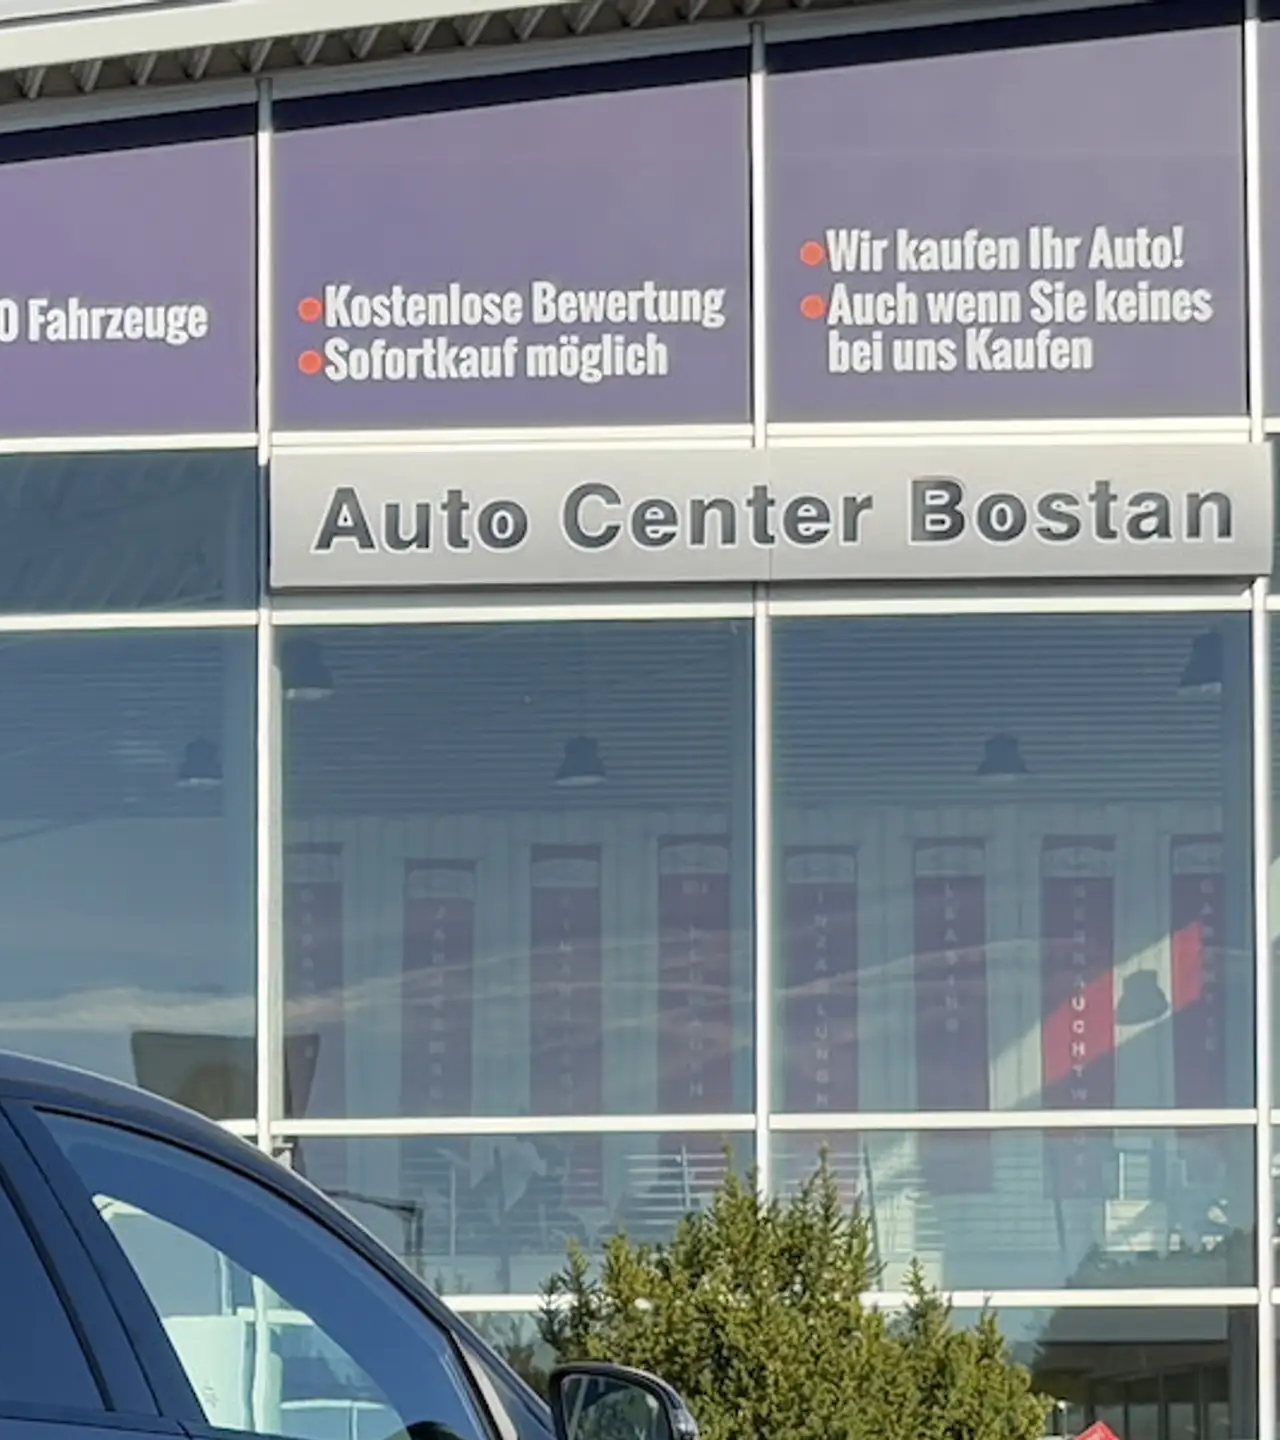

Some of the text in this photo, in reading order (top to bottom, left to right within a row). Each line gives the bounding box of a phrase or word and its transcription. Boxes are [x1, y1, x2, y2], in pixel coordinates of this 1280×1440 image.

[826, 225, 1184, 271] Wir kaufen Ihr Auto!
[28, 297, 208, 346] Fahrzeuge
[324, 280, 726, 328] Kostenlose Bewertung
[827, 279, 1214, 325] Auch wenn Sie keines
[324, 332, 668, 384] Sofortkauf möglich
[828, 327, 1093, 372] bei uns Kaufen
[312, 476, 1234, 551] Auto Center Bostan
